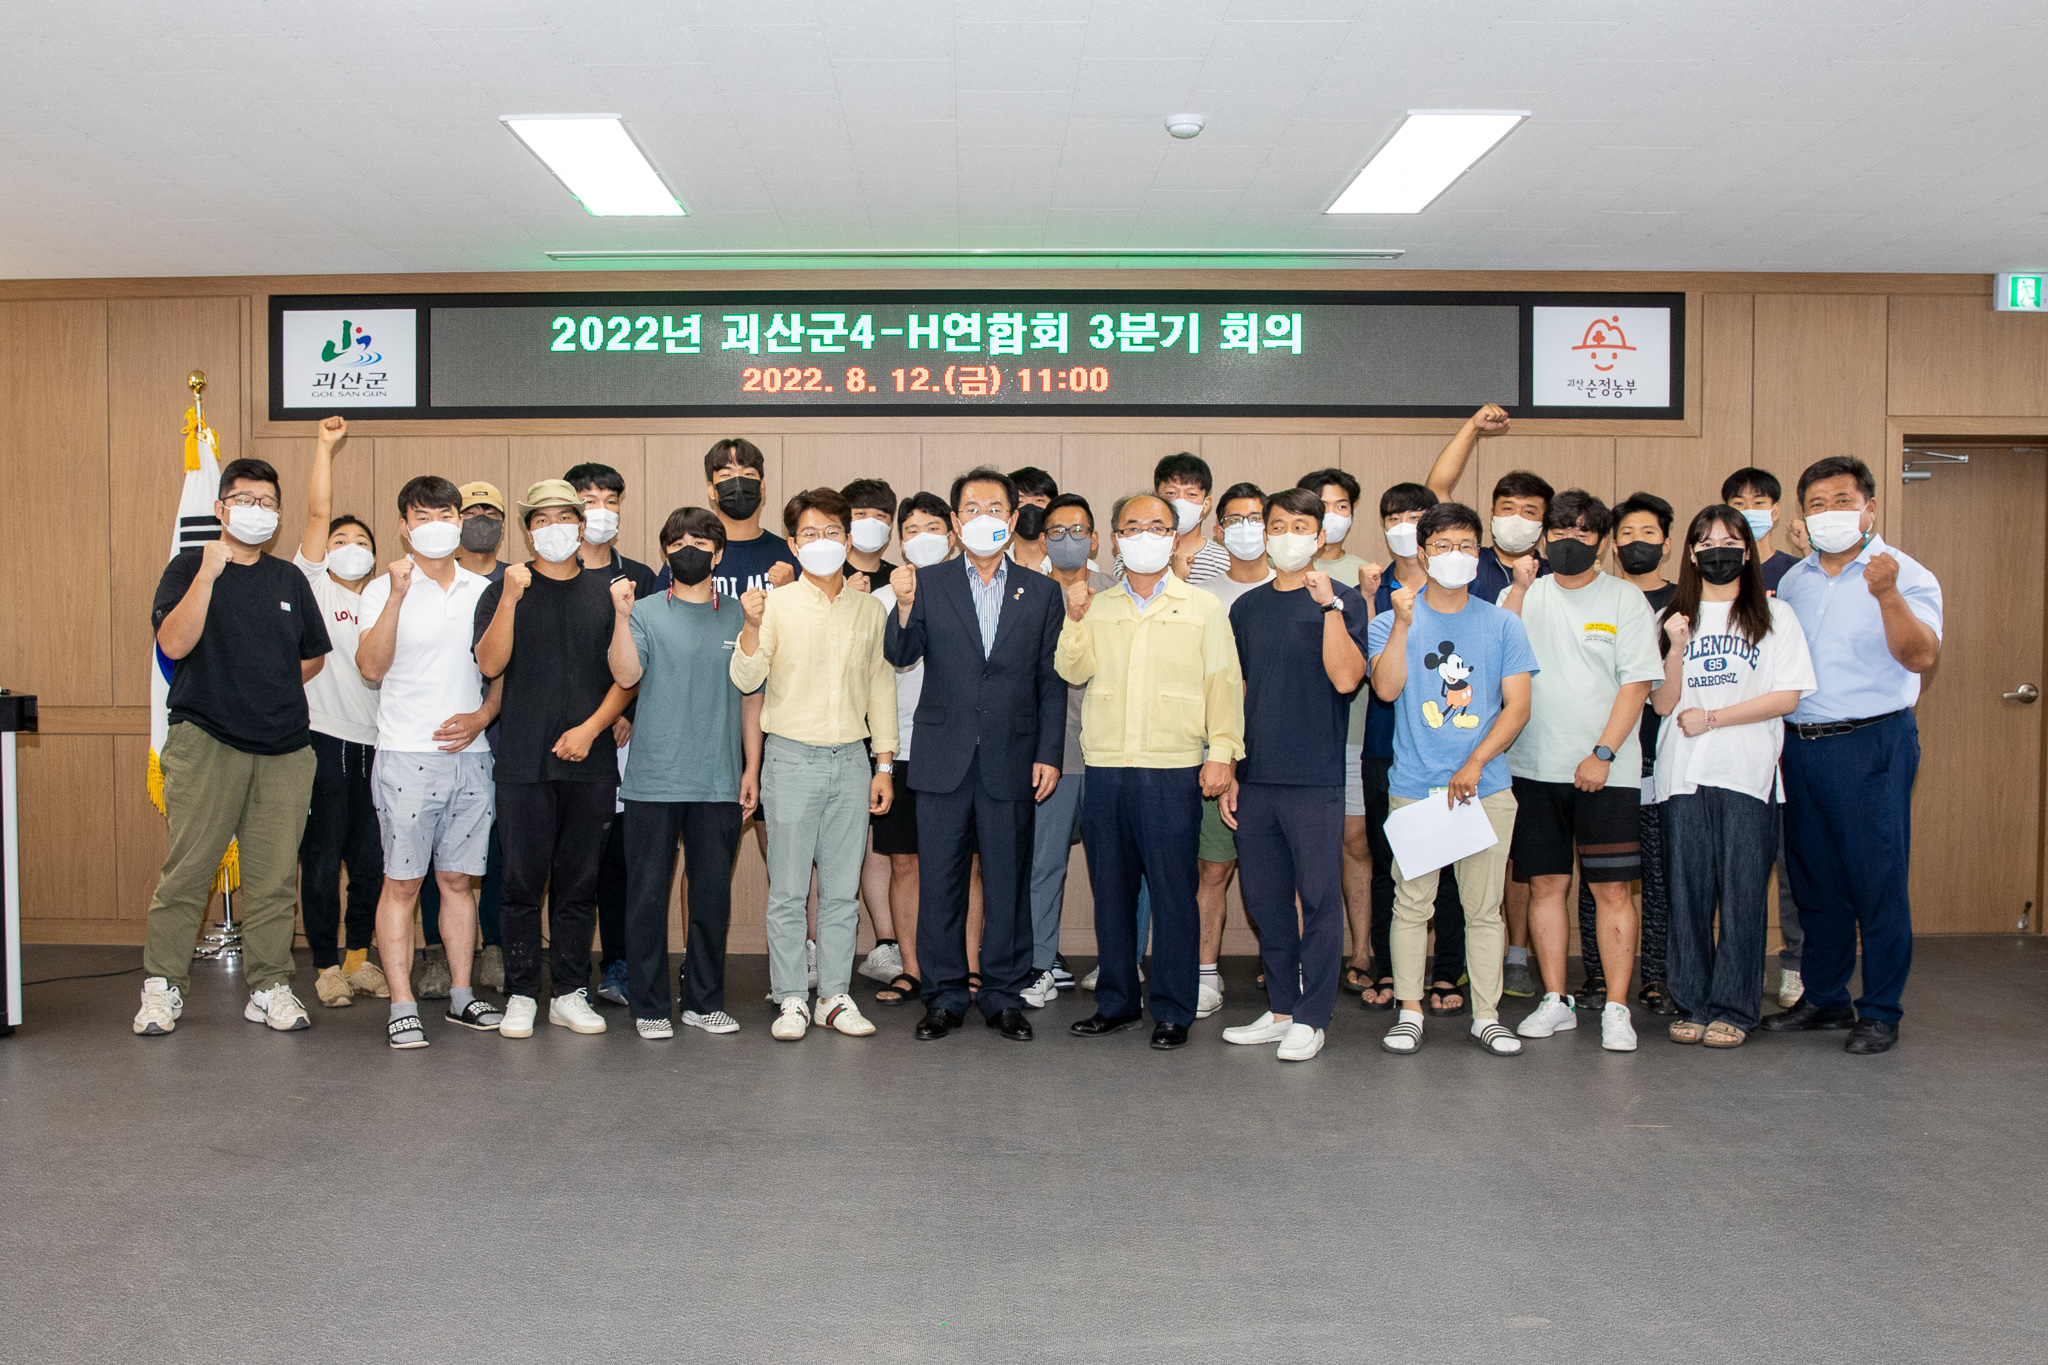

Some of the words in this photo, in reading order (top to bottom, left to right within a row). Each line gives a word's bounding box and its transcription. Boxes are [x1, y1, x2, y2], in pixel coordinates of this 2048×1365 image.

[550, 313, 702, 354] 2022년
[720, 312, 1070, 356] 괴산군4-H연합회
[1088, 312, 1200, 354] 3분기
[1219, 312, 1302, 355] 회의
[312, 371, 389, 390] 괴산군
[742, 366, 834, 393] 2022.
[846, 366, 877, 393] 8.
[891, 365, 1002, 396] 12.(금)
[1017, 366, 1109, 393] 11:00
[1566, 378, 1584, 391] 괴산
[1586, 377, 1637, 399] 순정농부
[362, 390, 388, 398] GUN
